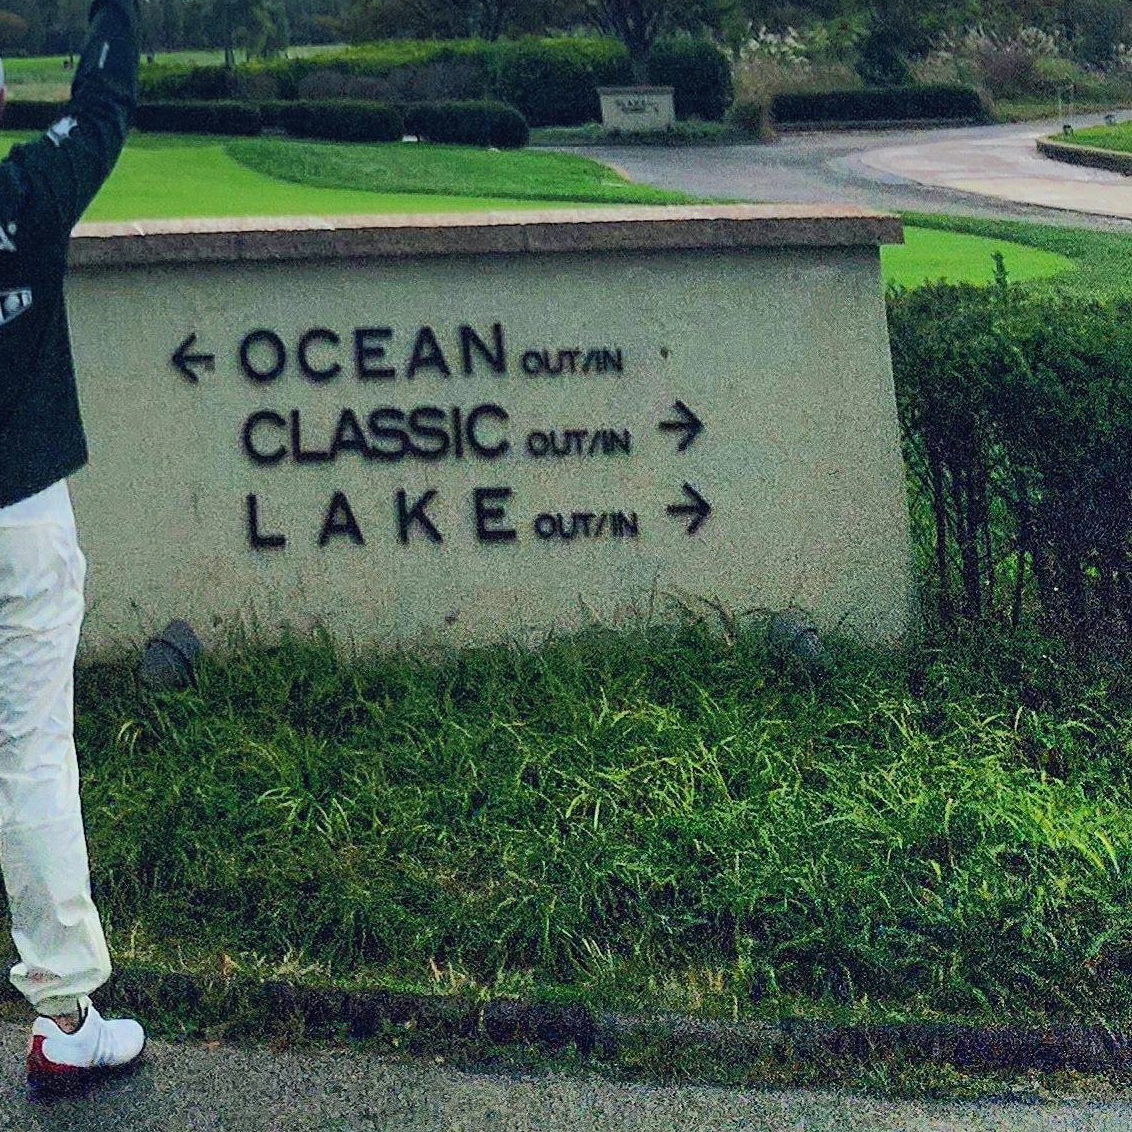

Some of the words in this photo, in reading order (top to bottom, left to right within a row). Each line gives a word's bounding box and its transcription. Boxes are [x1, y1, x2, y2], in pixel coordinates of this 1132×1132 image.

[238, 323, 507, 383] OCEAN
[519, 347, 624, 376] OUT/IN
[242, 403, 511, 466] CLASSIC
[527, 429, 631, 459] OUT/IN
[246, 487, 517, 549] LAKE
[533, 511, 639, 541] OUT/IN
